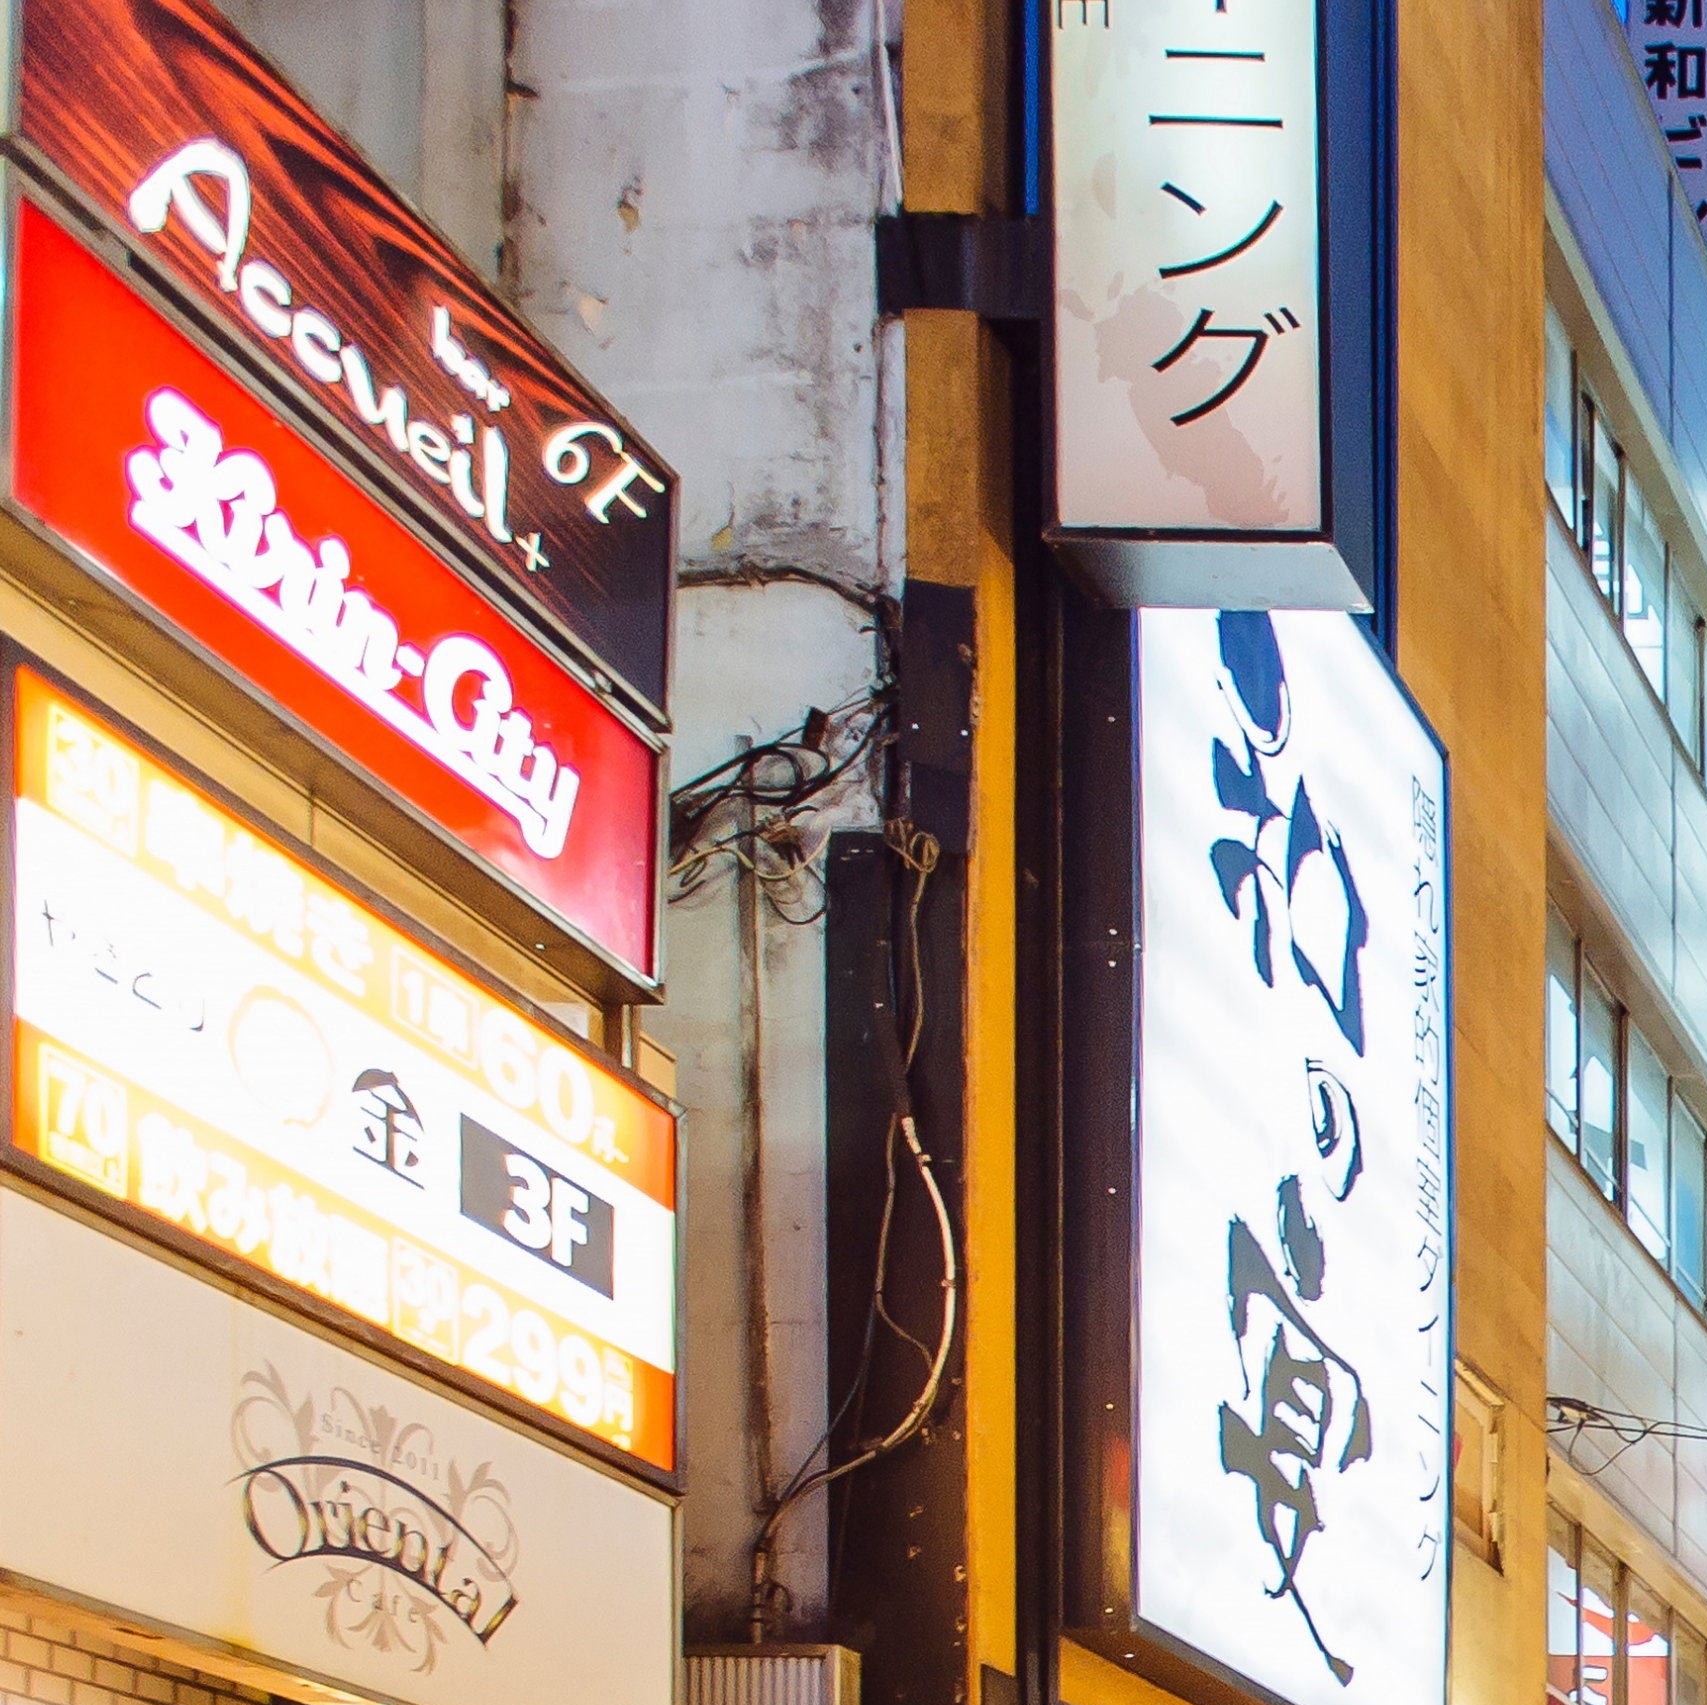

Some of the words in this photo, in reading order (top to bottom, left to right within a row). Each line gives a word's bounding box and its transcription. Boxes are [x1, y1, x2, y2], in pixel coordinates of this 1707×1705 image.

[1644, 0, 1707, 223] 新和ビ
[1149, 0, 1301, 428] ニング
[128, 137, 513, 543] Accueil
[431, 305, 510, 412] bar
[542, 422, 664, 524] 6F
[125, 386, 581, 859] Kirin-City
[350, 1067, 427, 1191] 金
[505, 1153, 590, 1267] 3F
